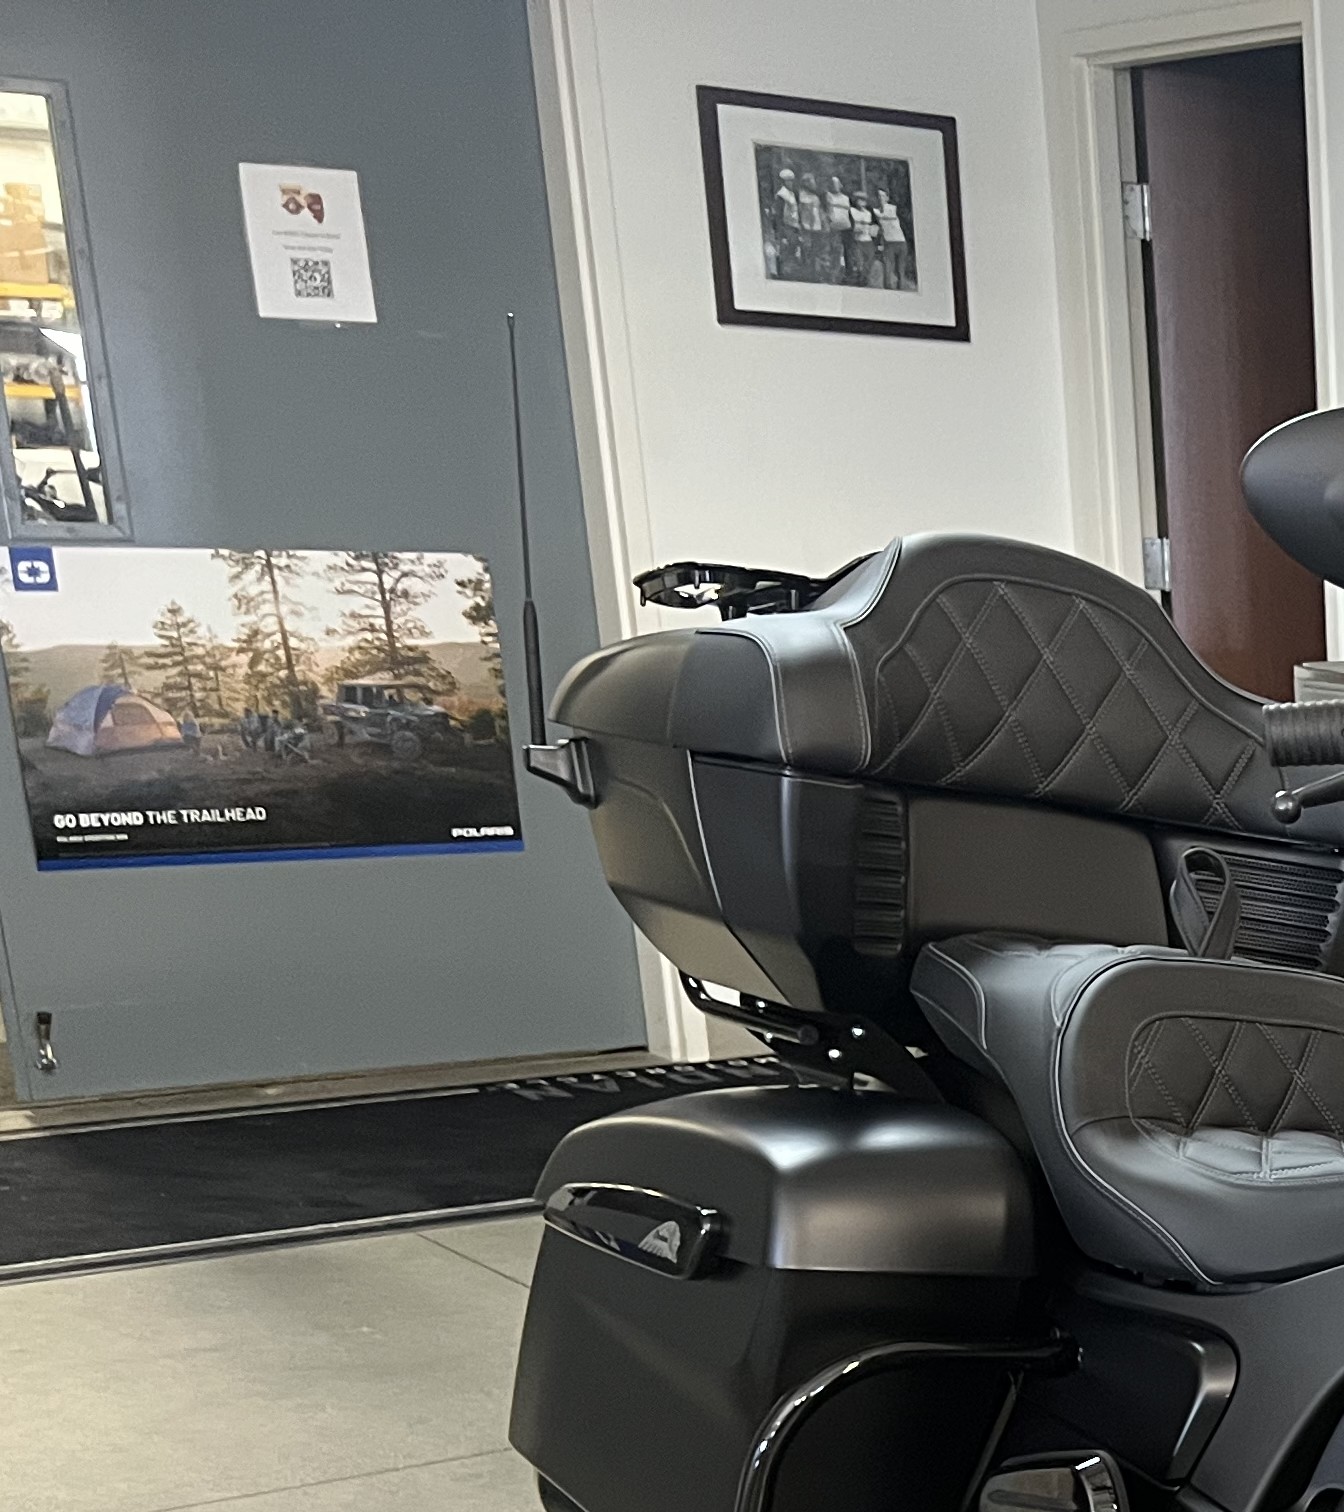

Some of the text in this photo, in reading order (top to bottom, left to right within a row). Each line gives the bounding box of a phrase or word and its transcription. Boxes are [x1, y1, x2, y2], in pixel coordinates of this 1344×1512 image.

[53, 806, 267, 828] GO BEYOND THE TRAILHEAD
[451, 825, 514, 838] POLARIS
